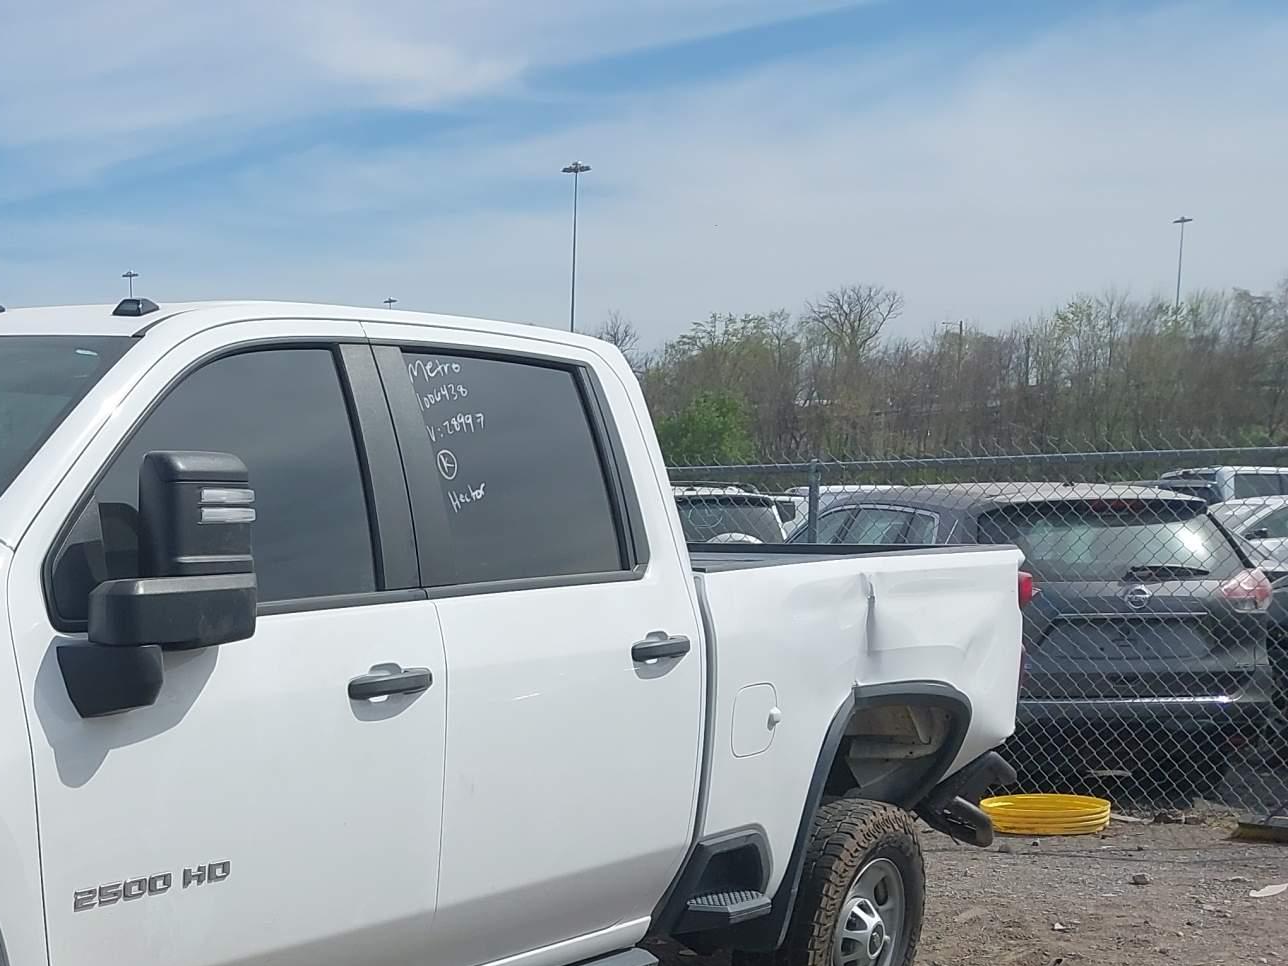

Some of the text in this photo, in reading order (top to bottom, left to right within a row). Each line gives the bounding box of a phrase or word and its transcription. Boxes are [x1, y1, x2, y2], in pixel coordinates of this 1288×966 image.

[408, 359, 461, 383] Metro
[416, 383, 468, 411] 1006438
[73, 860, 231, 913] 2500 HD
